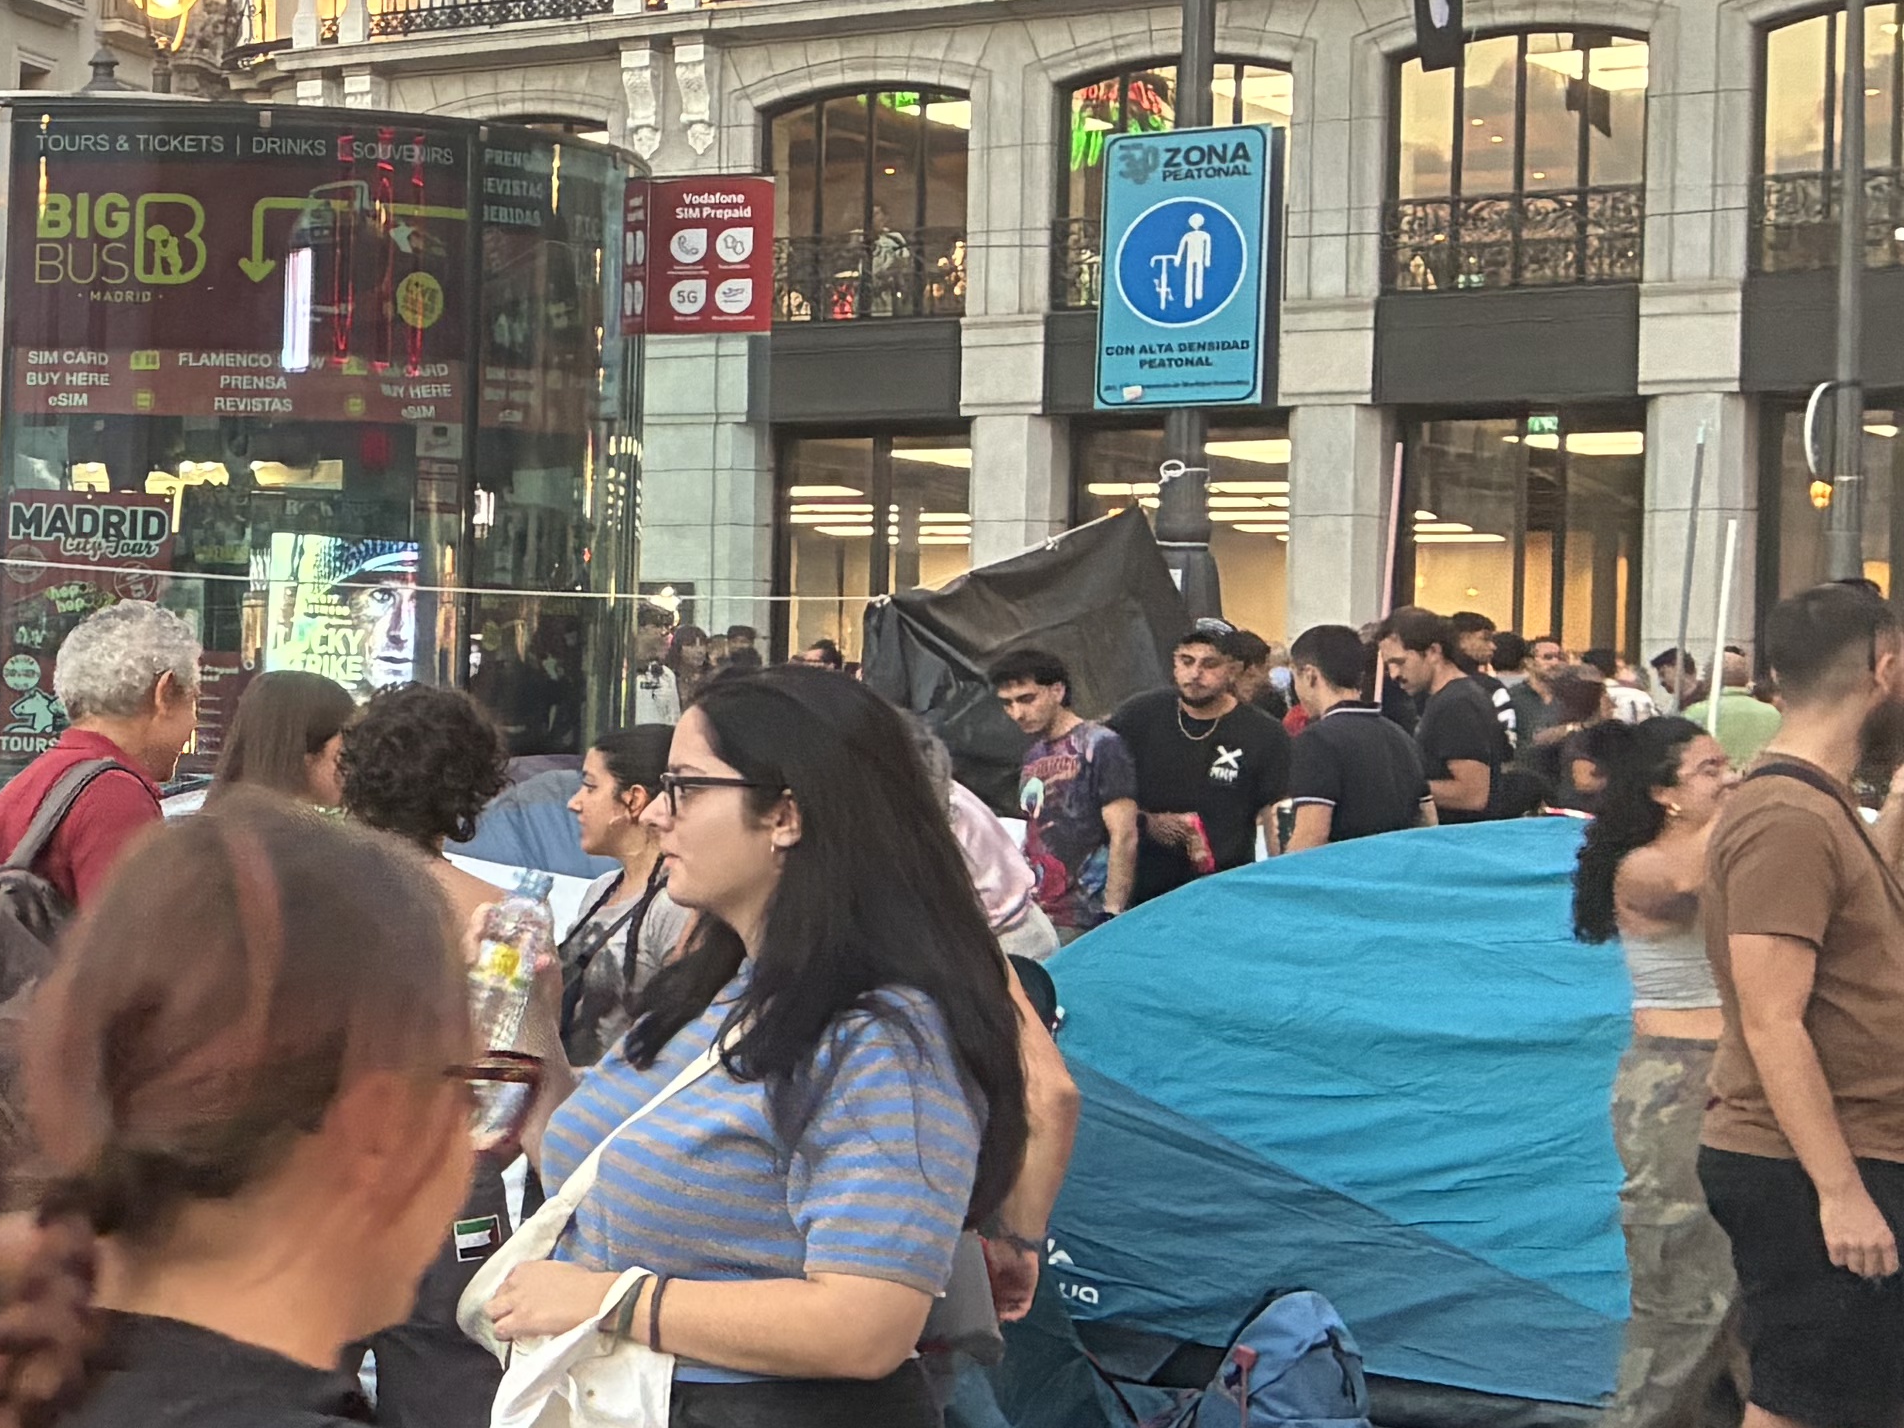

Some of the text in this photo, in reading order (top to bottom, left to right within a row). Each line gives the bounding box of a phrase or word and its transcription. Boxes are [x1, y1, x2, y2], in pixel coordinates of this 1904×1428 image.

[36, 133, 454, 165] TOURS & TICKETS DRINKS SOUVENIRS
[1163, 142, 1251, 169] ZONA
[1162, 164, 1252, 182] PEATONAL
[683, 192, 746, 205] Vodafone
[37, 192, 131, 239] BIG
[675, 206, 752, 220] SIM Prepaid
[34, 242, 128, 285] BUS
[89, 290, 152, 303] MADRID
[677, 290, 698, 304] 5G
[1106, 340, 1250, 357] CON ALTA DENSIDAD
[28, 351, 109, 366] SIM CARD
[178, 352, 272, 369] FLAMENCO
[1139, 356, 1213, 370] PEATONAL
[26, 372, 111, 387] BUY HERE
[220, 374, 288, 390] PRENSA
[409, 383, 452, 399] HERE
[48, 392, 88, 407] eSIM
[214, 397, 293, 413] REVISTAS
[8, 502, 170, 542] MADRID
[60, 535, 159, 560] City Tour
